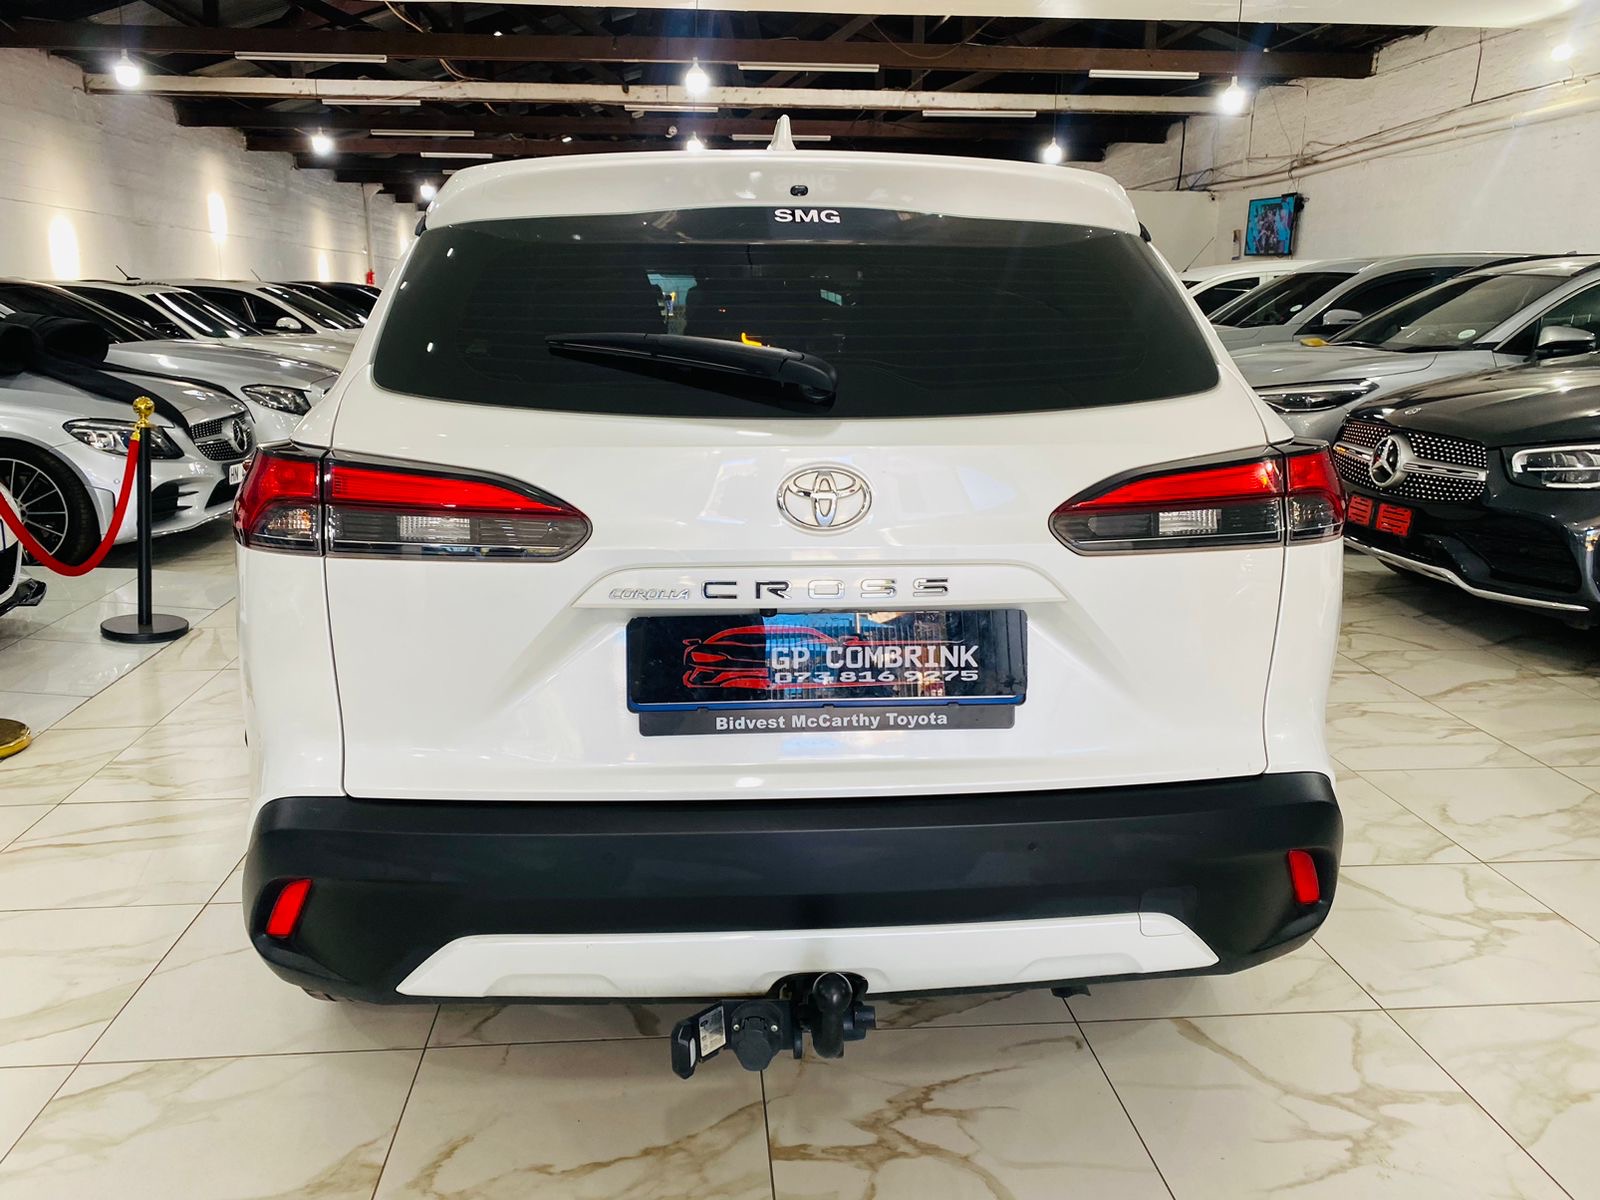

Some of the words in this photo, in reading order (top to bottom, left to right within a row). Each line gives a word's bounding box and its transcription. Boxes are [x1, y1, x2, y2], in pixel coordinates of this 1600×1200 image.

[774, 208, 840, 223] SMG
[609, 588, 690, 600] COROLLA
[701, 578, 949, 600] CROSS
[771, 647, 810, 669] GP
[826, 645, 979, 669] COMBRINK
[774, 671, 833, 684] 073
[839, 670, 896, 683] 816
[903, 670, 979, 682] 9275
[715, 716, 785, 730] Bidvest
[791, 714, 880, 729] McCarthy
[886, 712, 948, 728] Toyota
